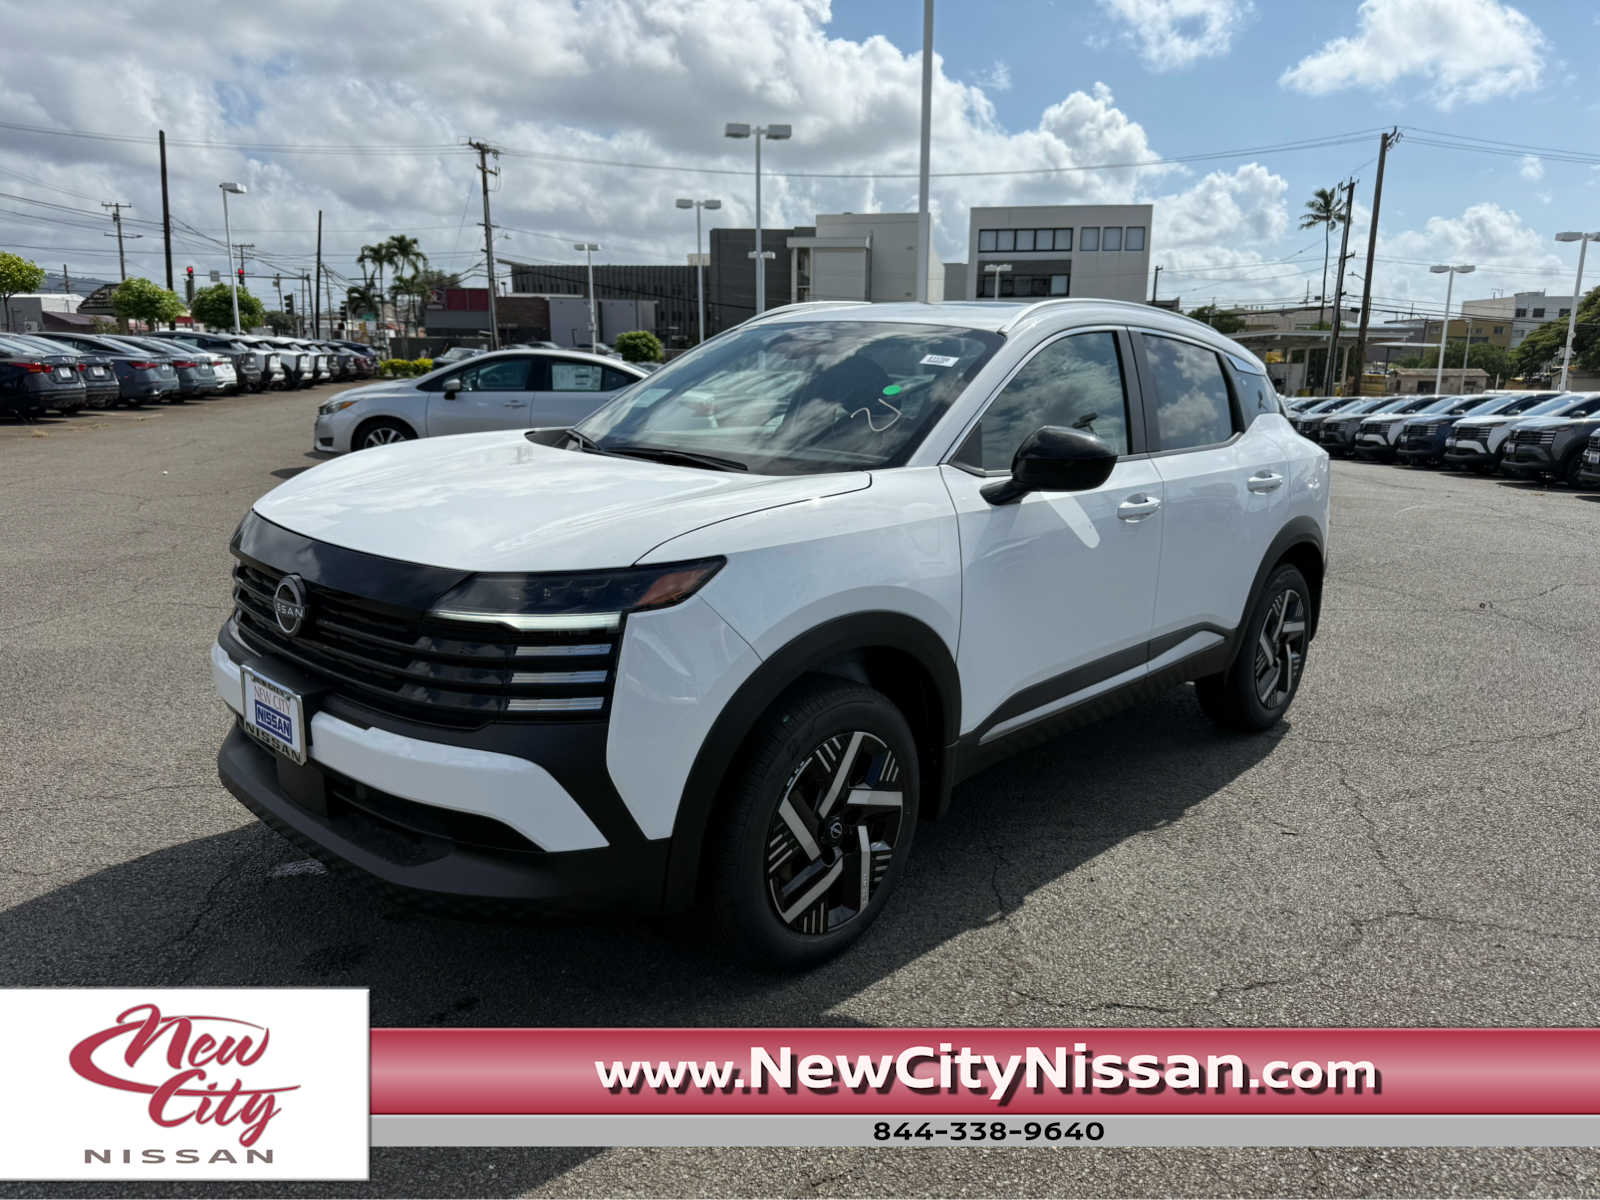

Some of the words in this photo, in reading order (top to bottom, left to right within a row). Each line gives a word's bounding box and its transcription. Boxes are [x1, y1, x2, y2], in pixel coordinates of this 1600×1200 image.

[254, 685, 272, 706] NEW
[272, 694, 291, 715] CITY
[256, 705, 291, 737] NISSAN
[244, 723, 302, 761] NISSAN
